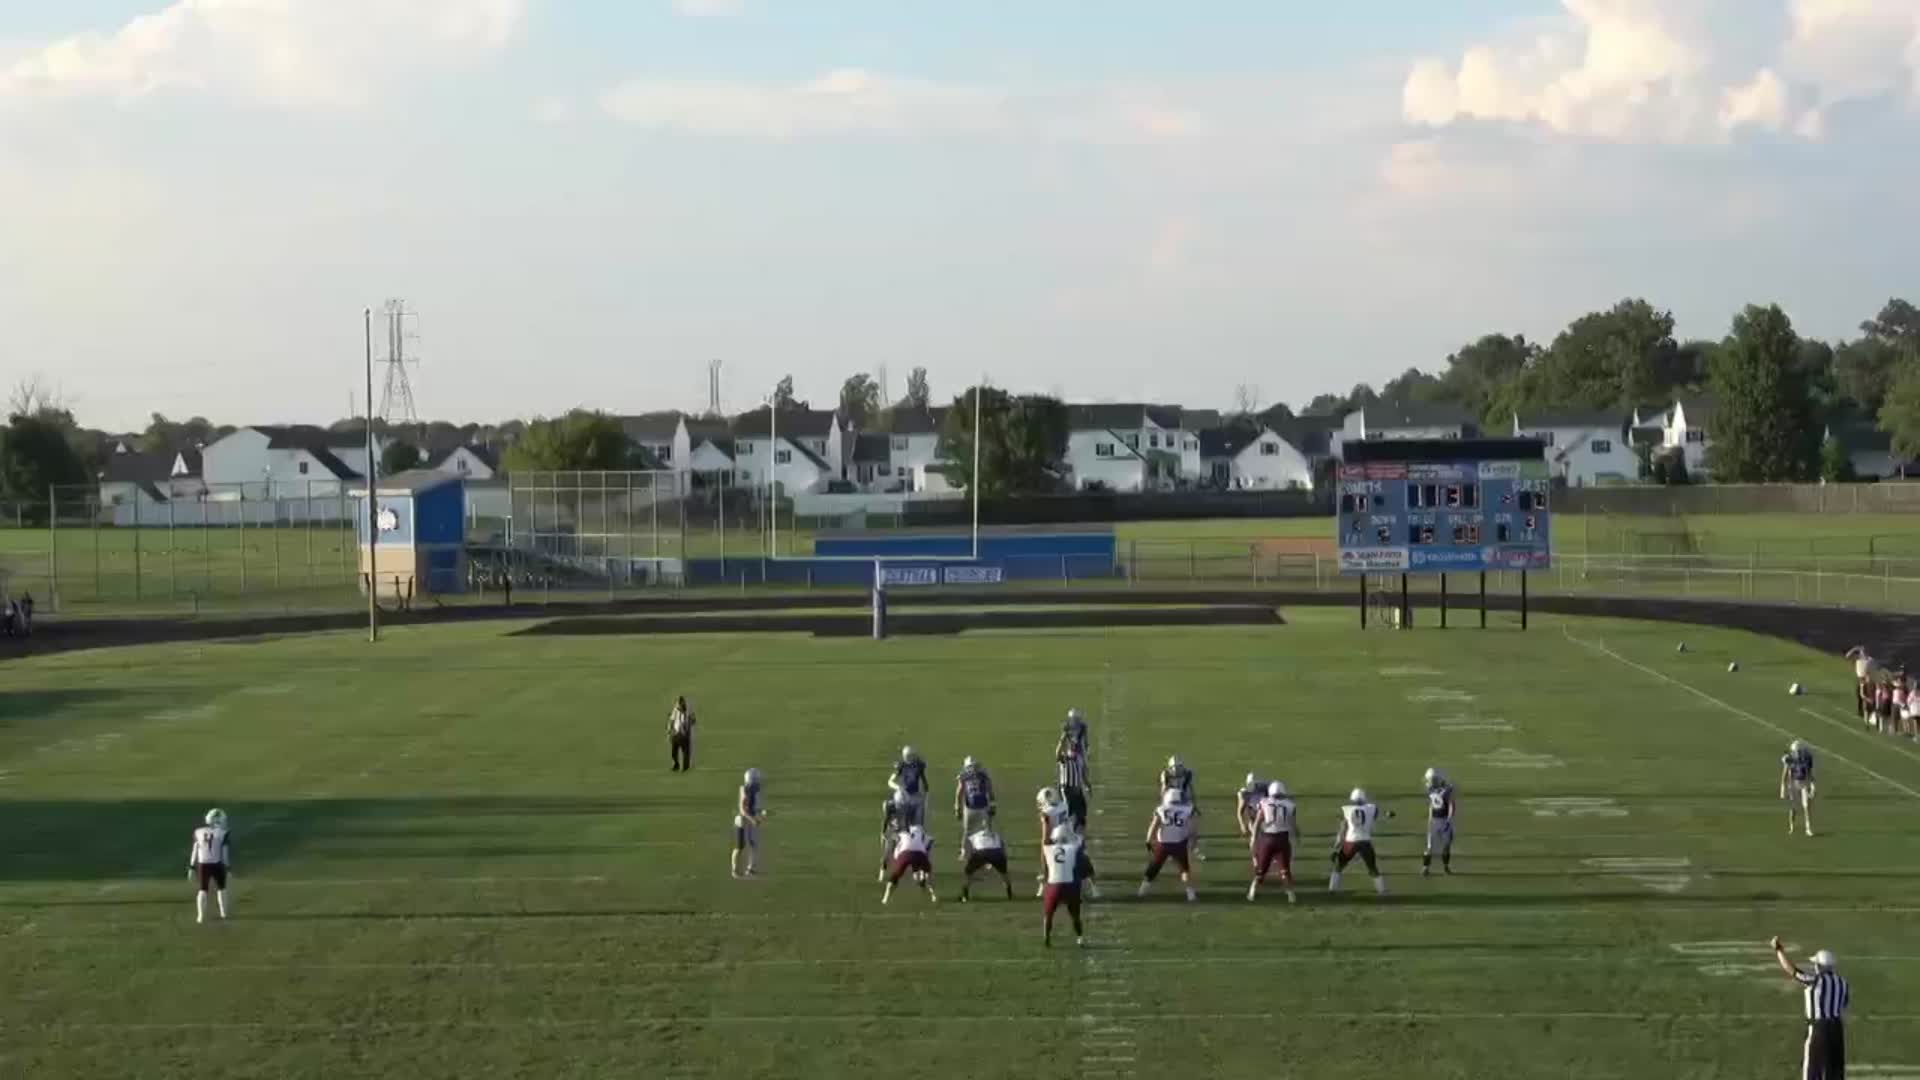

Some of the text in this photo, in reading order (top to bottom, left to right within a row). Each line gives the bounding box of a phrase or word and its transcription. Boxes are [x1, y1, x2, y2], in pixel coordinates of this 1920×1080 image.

[1163, 809, 1185, 827] 56
[1354, 808, 1366, 825] 9
[1054, 847, 1066, 864] 2
